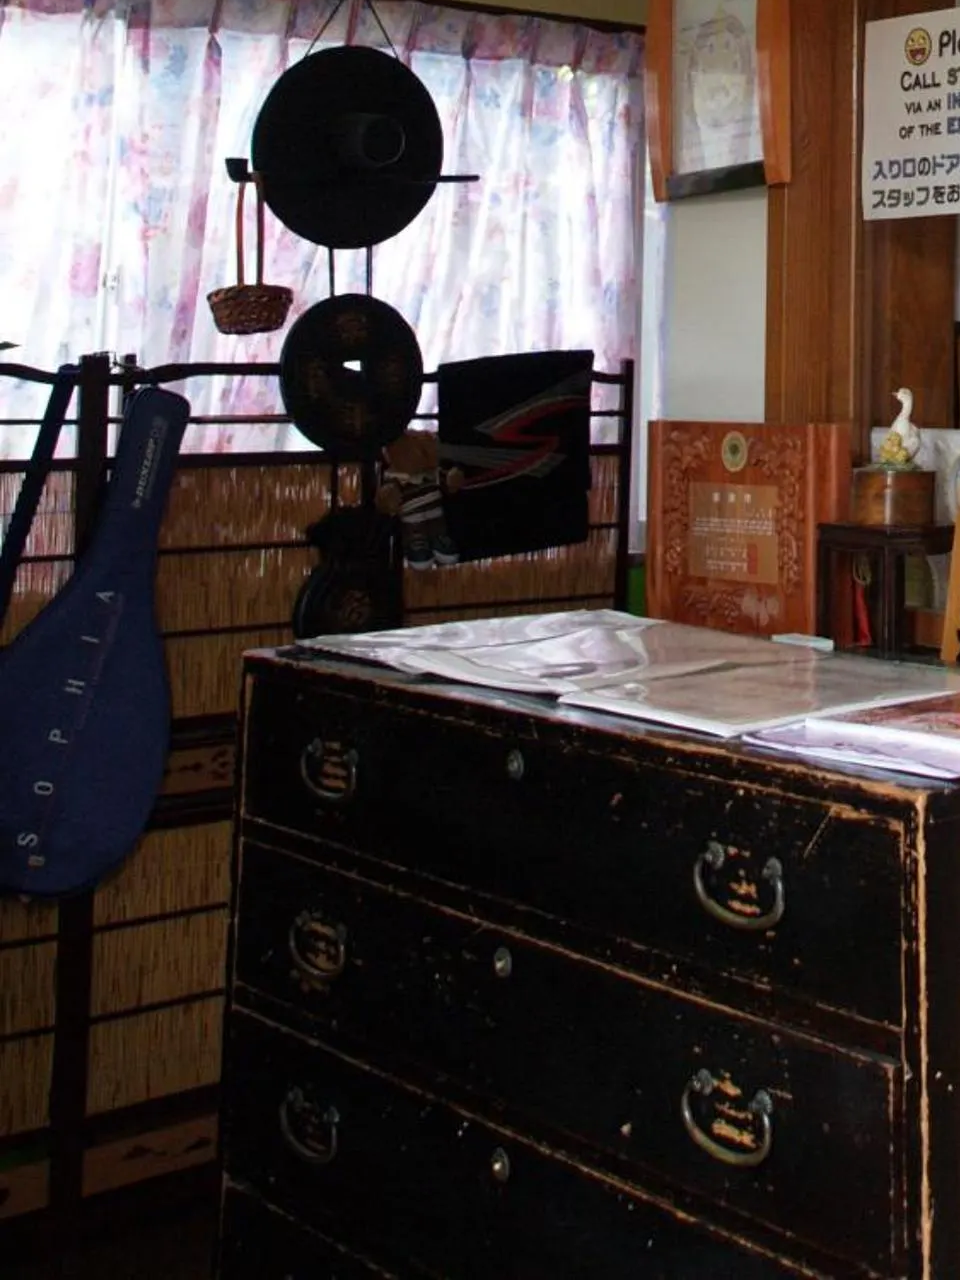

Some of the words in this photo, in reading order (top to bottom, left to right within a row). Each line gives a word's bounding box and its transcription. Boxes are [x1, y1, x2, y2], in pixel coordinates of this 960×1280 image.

[900, 71, 941, 91] CALL
[904, 101, 922, 114] VIA
[926, 99, 941, 112] AN
[899, 125, 915, 139] OF
[918, 123, 942, 136] THE
[17, 589, 116, 848] SOPHIA
